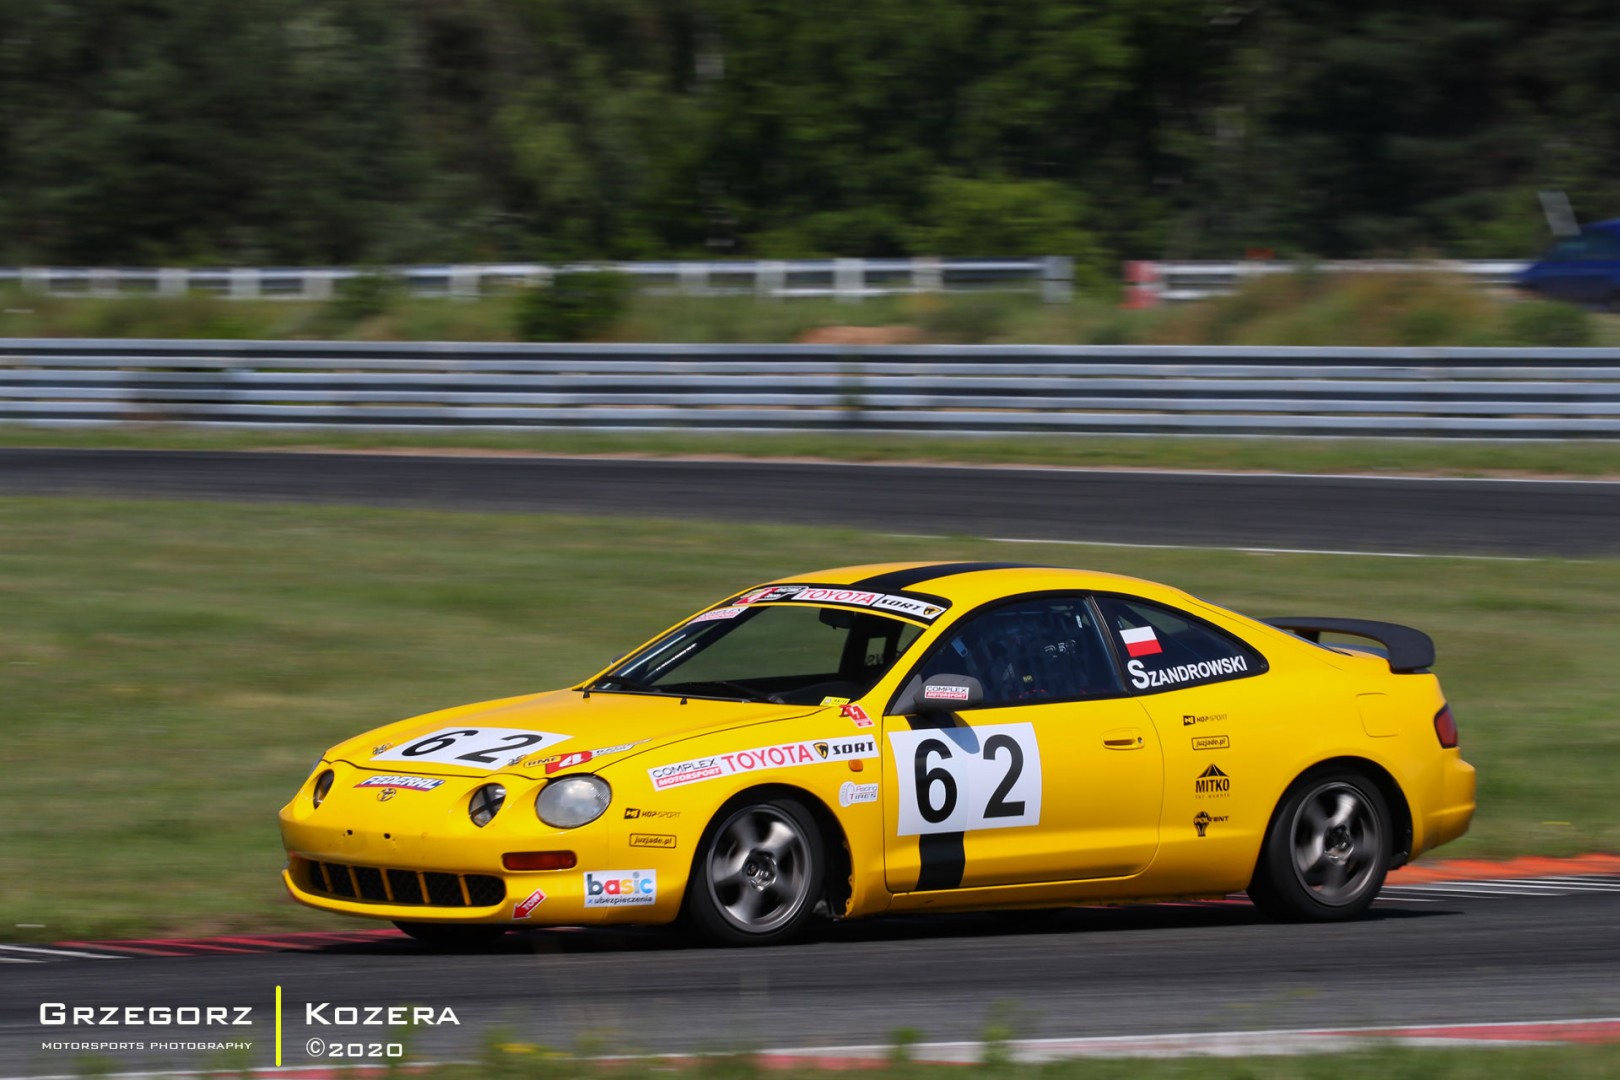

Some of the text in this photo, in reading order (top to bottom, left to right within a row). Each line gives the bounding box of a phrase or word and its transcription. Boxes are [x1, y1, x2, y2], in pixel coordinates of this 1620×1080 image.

[800, 588, 876, 604] TOYOTA
[1127, 655, 1248, 689] SZANDROWSKI
[401, 730, 543, 763] 62
[832, 742, 874, 755] SORT
[652, 758, 718, 778] COMPLEX
[721, 744, 814, 772] TOYOTA
[659, 767, 720, 786] MOTORSPORT
[914, 734, 1025, 823] 62
[1195, 778, 1230, 793] MITKO
[587, 871, 653, 896] basic
[594, 896, 653, 905] ubezpieczenia
